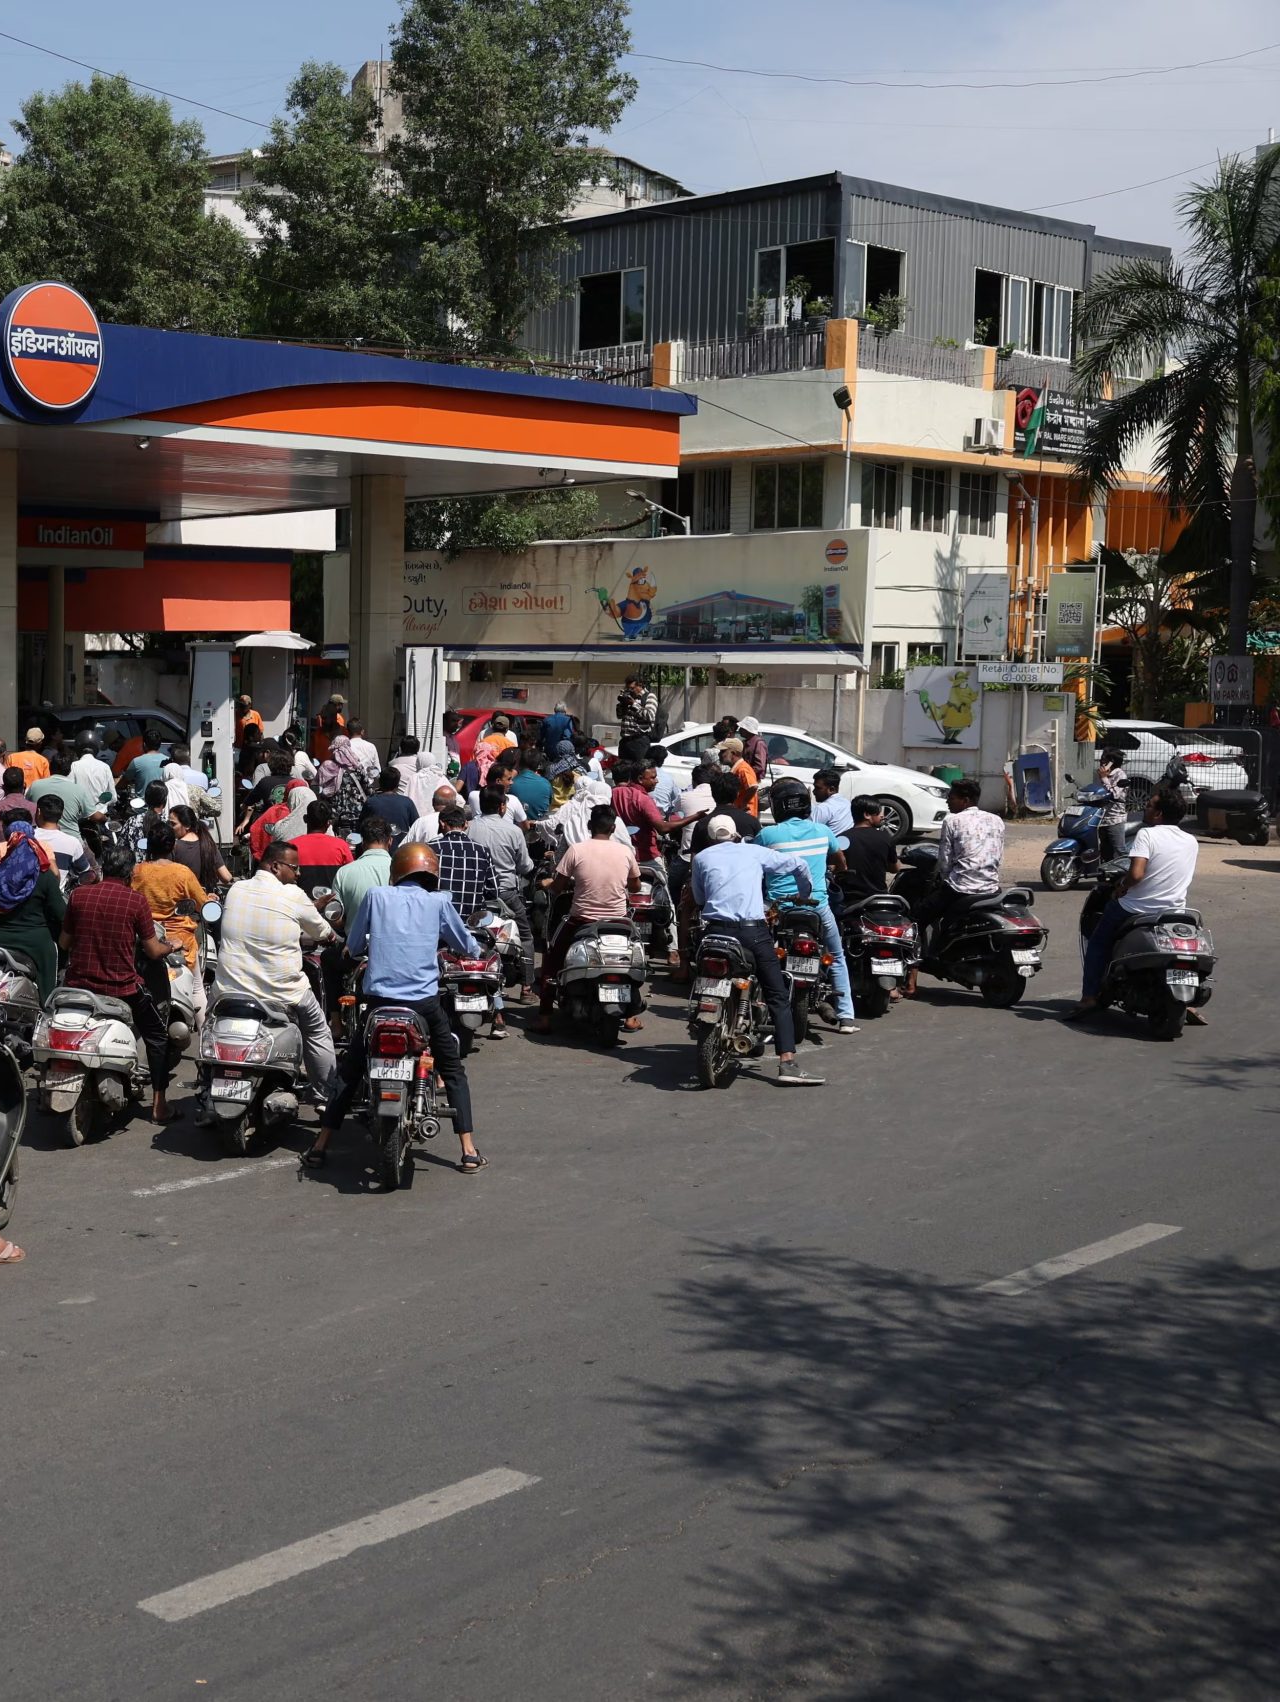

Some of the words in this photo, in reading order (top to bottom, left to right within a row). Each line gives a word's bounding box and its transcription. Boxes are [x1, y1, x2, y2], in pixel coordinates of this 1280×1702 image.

[10, 327, 99, 359] इंडियनऑयल
[38, 524, 113, 546] IndianOil
[500, 582, 531, 590] IndianOil
[468, 591, 507, 613] હંમેશા
[511, 592, 564, 613] ઓપન!
[982, 664, 1008, 673] Retail
[1010, 664, 1041, 674] Outlet
[1043, 665, 1060, 674] No.
[1001, 674, 1038, 682] GJ-0038
[383, 1060, 405, 1069] GJ01
